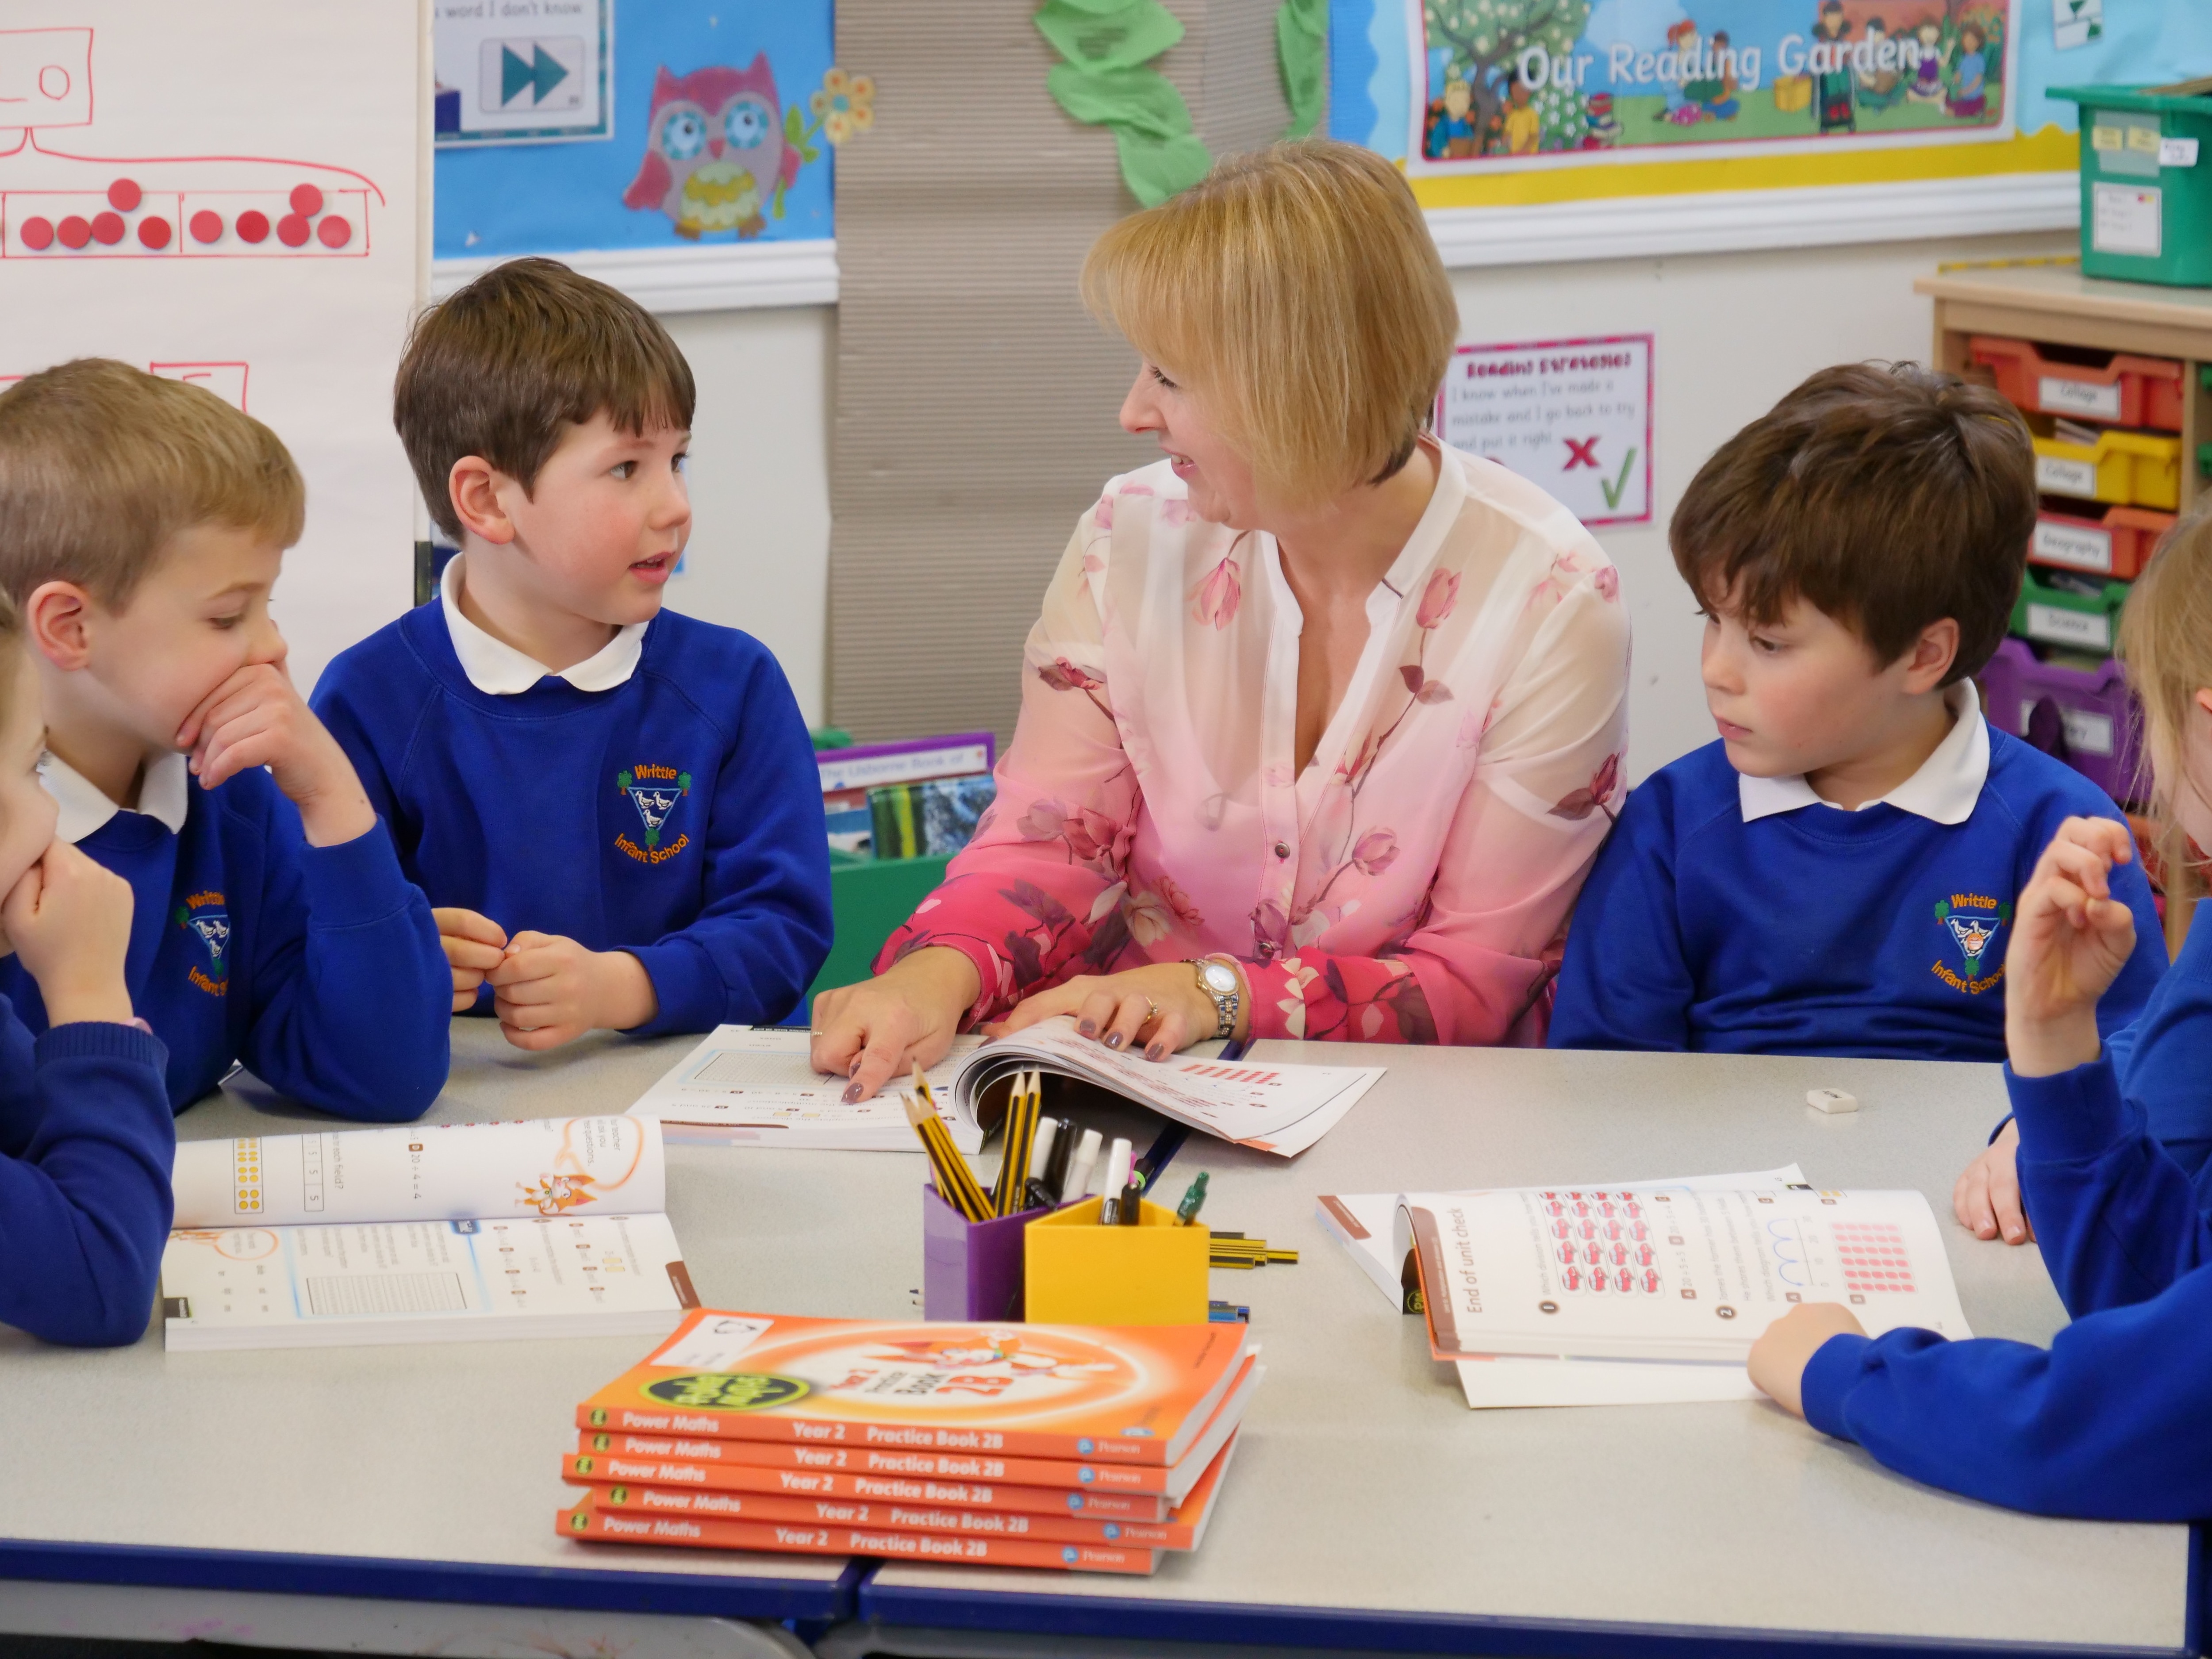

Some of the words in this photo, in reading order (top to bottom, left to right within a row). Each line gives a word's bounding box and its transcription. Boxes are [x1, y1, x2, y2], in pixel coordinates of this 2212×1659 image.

[1518, 45, 1593, 90] Our
[1609, 36, 1762, 92] Reading
[1777, 26, 1922, 74] Garden
[634, 763, 677, 780] Writtle
[614, 833, 648, 863] Infant
[650, 833, 689, 864] School
[1951, 892, 1997, 910] Writtle
[1931, 959, 1967, 993] Infant
[1447, 1207, 1469, 1238] check
[1455, 1240, 1474, 1266] unit
[1459, 1269, 1477, 1284] of
[1463, 1288, 1482, 1313] End
[893, 1371, 948, 1395] Book
[936, 1375, 1017, 1396] 2B
[622, 1412, 671, 1430] Power
[674, 1414, 719, 1433] Maths
[793, 1421, 831, 1440] Year
[834, 1424, 845, 1440] 2
[868, 1426, 934, 1448] Practice
[937, 1429, 979, 1448] Book
[982, 1433, 1004, 1449] 2B
[1099, 1442, 1141, 1455] Pearson
[626, 1438, 672, 1456] Power
[675, 1440, 722, 1459] Maths
[795, 1448, 833, 1467] Year
[836, 1451, 847, 1467] 2
[869, 1453, 934, 1474] Practice
[938, 1456, 980, 1475] Book
[983, 1462, 1005, 1477] 2B
[1100, 1471, 1141, 1485] Pearson
[609, 1461, 656, 1479] Power
[659, 1463, 706, 1483] Maths
[781, 1472, 820, 1491] Year
[823, 1476, 833, 1492] 2
[856, 1478, 922, 1500] Practice
[926, 1481, 968, 1501] Book
[971, 1488, 993, 1503] 2B
[1087, 1497, 1130, 1511] Pearson
[644, 1491, 691, 1508] Power
[694, 1495, 741, 1513] Maths
[816, 1503, 855, 1521] Year
[858, 1506, 868, 1521] 2
[891, 1509, 957, 1530] Practice
[961, 1510, 1003, 1531] Book
[1006, 1517, 1029, 1533] 2B
[1125, 1527, 1167, 1541] Pearson
[604, 1517, 651, 1534] Power
[654, 1519, 701, 1539] Maths
[776, 1528, 815, 1546] Year
[818, 1531, 828, 1546] 2
[850, 1533, 917, 1553] Practice
[920, 1534, 962, 1555] Book
[965, 1541, 987, 1557] 2B
[1083, 1549, 1125, 1564] Pearson
